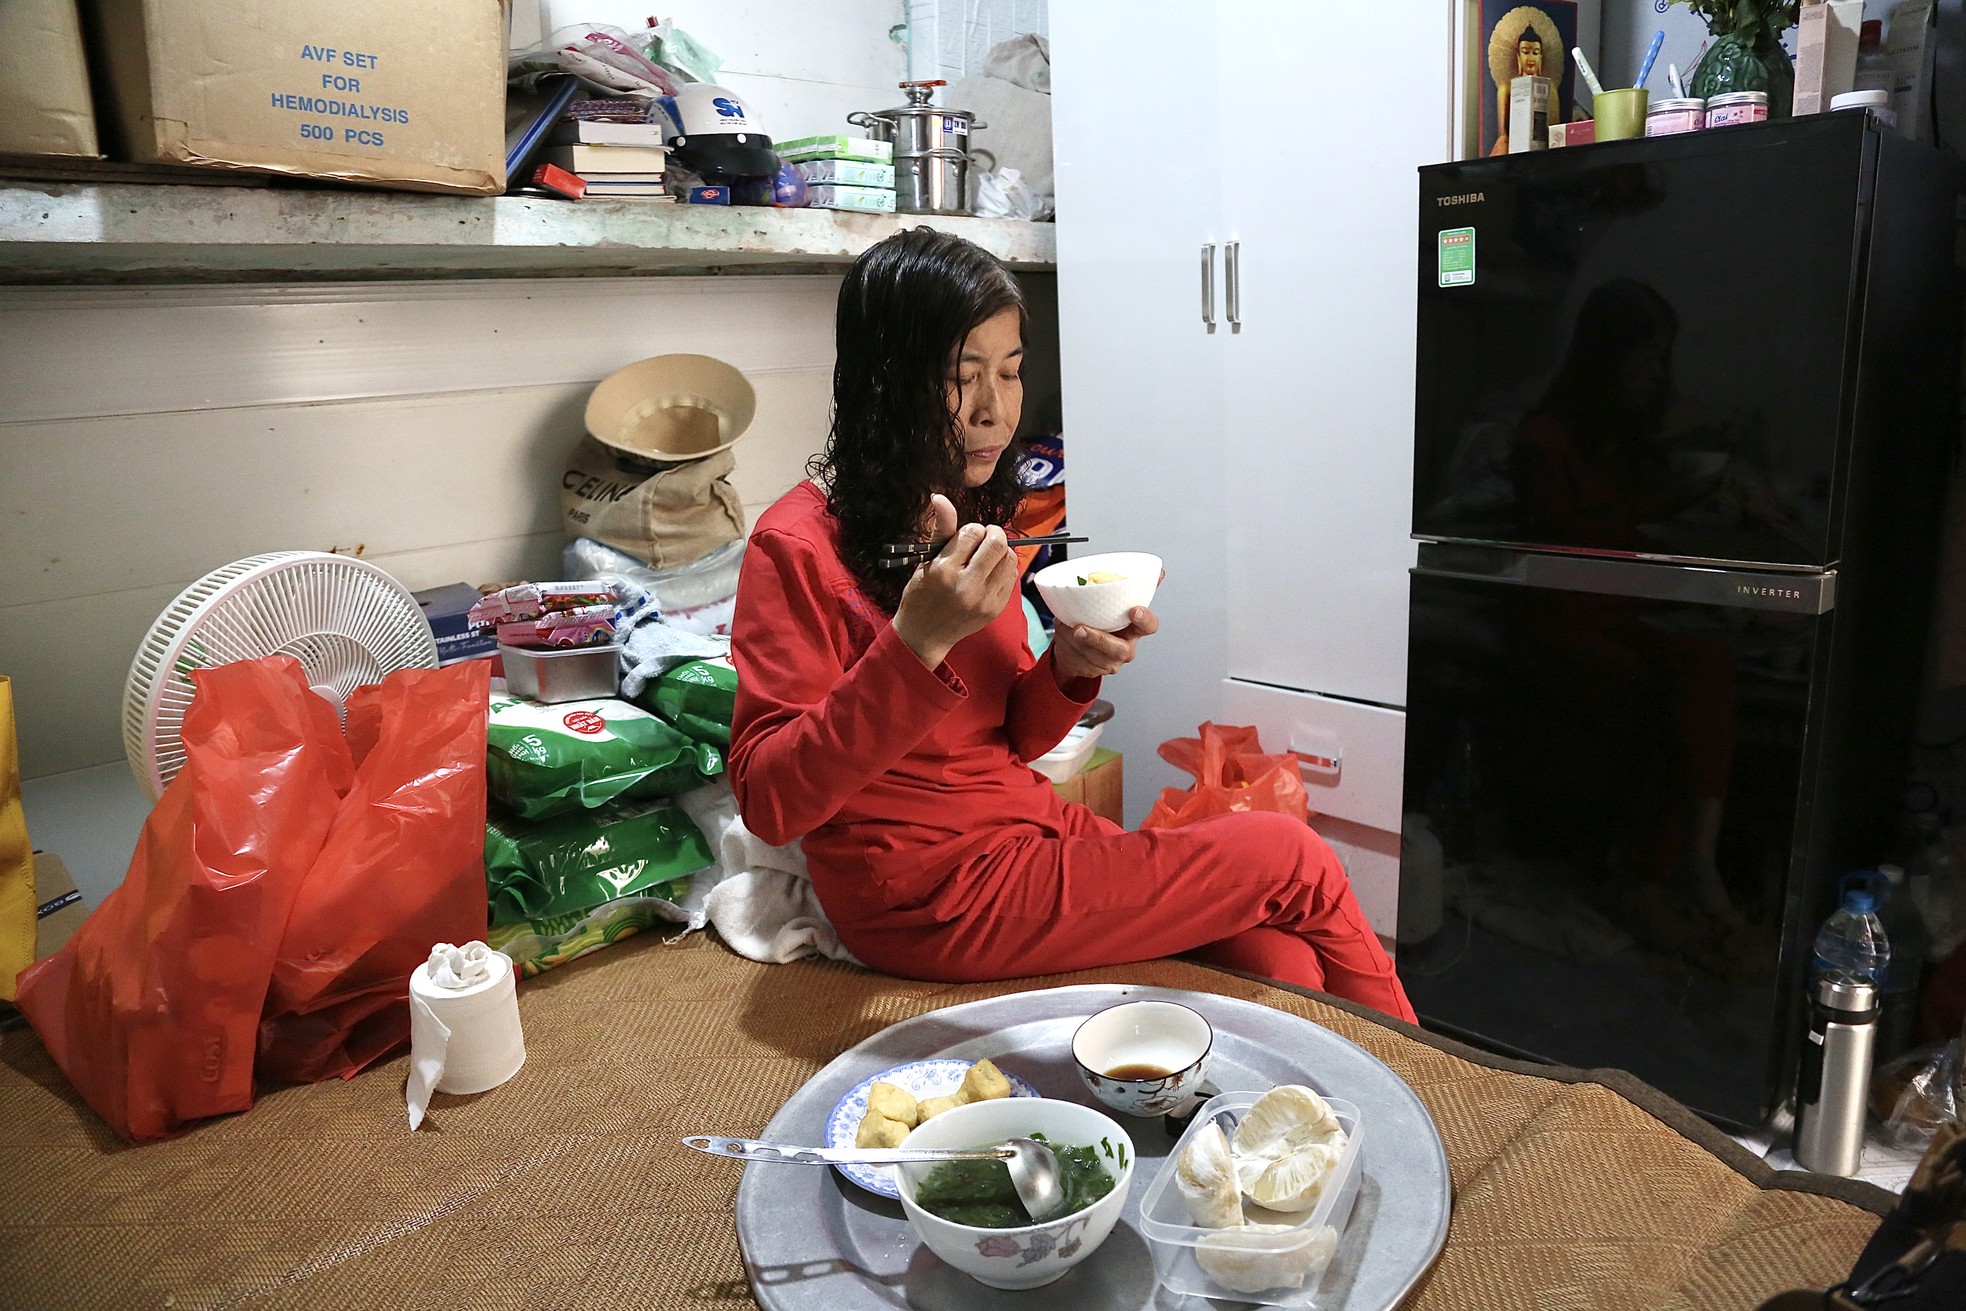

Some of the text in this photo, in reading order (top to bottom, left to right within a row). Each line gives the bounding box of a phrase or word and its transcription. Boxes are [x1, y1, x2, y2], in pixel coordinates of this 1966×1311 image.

[301, 44, 378, 70] AVF SET
[322, 74, 361, 93] FOR
[271, 93, 409, 124] HEMODIALYSIS
[300, 123, 385, 147] 500 PCS
[1436, 192, 1486, 207] TOSHIBA
[1737, 585, 1801, 599] INVERTER
[434, 631, 471, 645] TAINLESS
[691, 665, 710, 676] 5
[522, 734, 542, 746] 5
